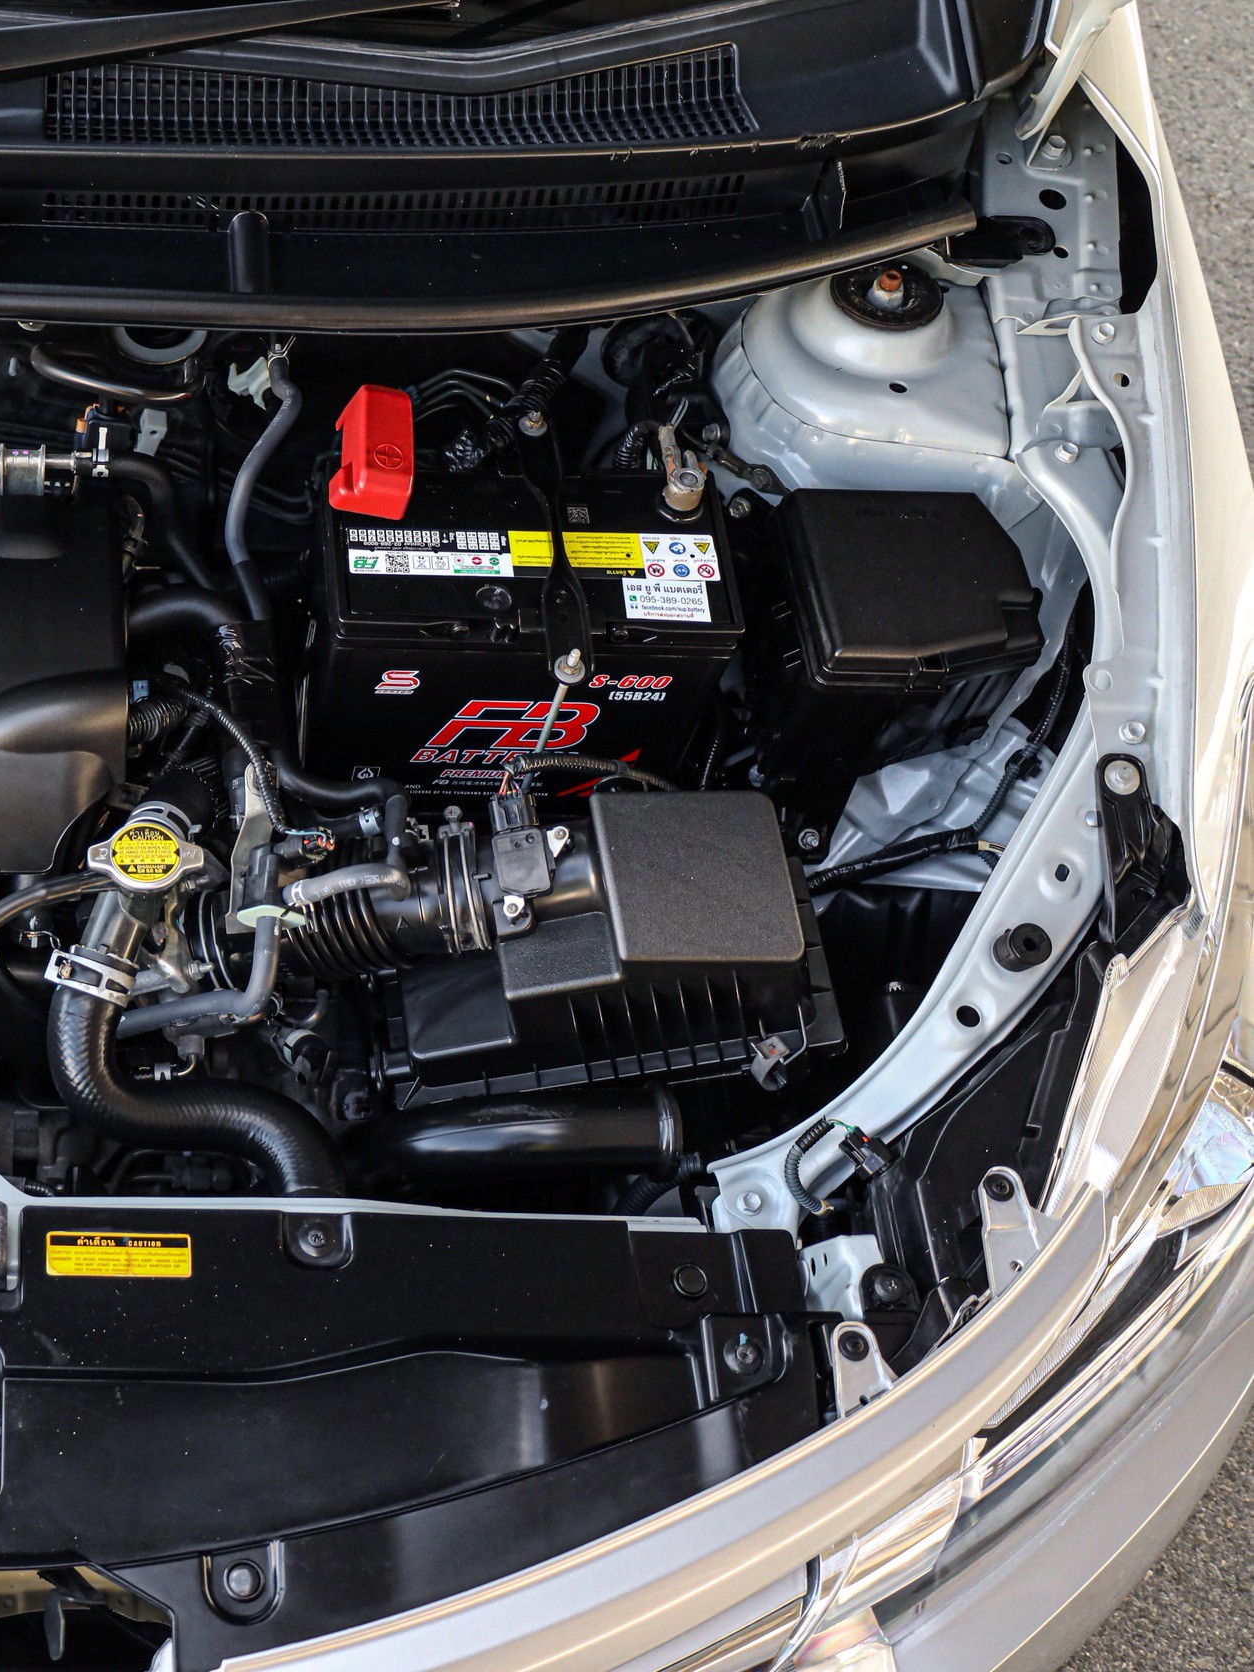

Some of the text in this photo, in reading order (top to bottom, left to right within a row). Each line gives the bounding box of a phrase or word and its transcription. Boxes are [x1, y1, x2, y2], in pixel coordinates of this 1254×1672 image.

[353, 559, 378, 569] FB
[645, 584, 651, 595] ยู
[653, 583, 661, 592] พี
[640, 595, 703, 605] 095-389-0265
[588, 674, 672, 689] S-600
[608, 691, 666, 701] (55B24)
[424, 700, 600, 750] FB
[77, 1236, 116, 1246] คำเตือน
